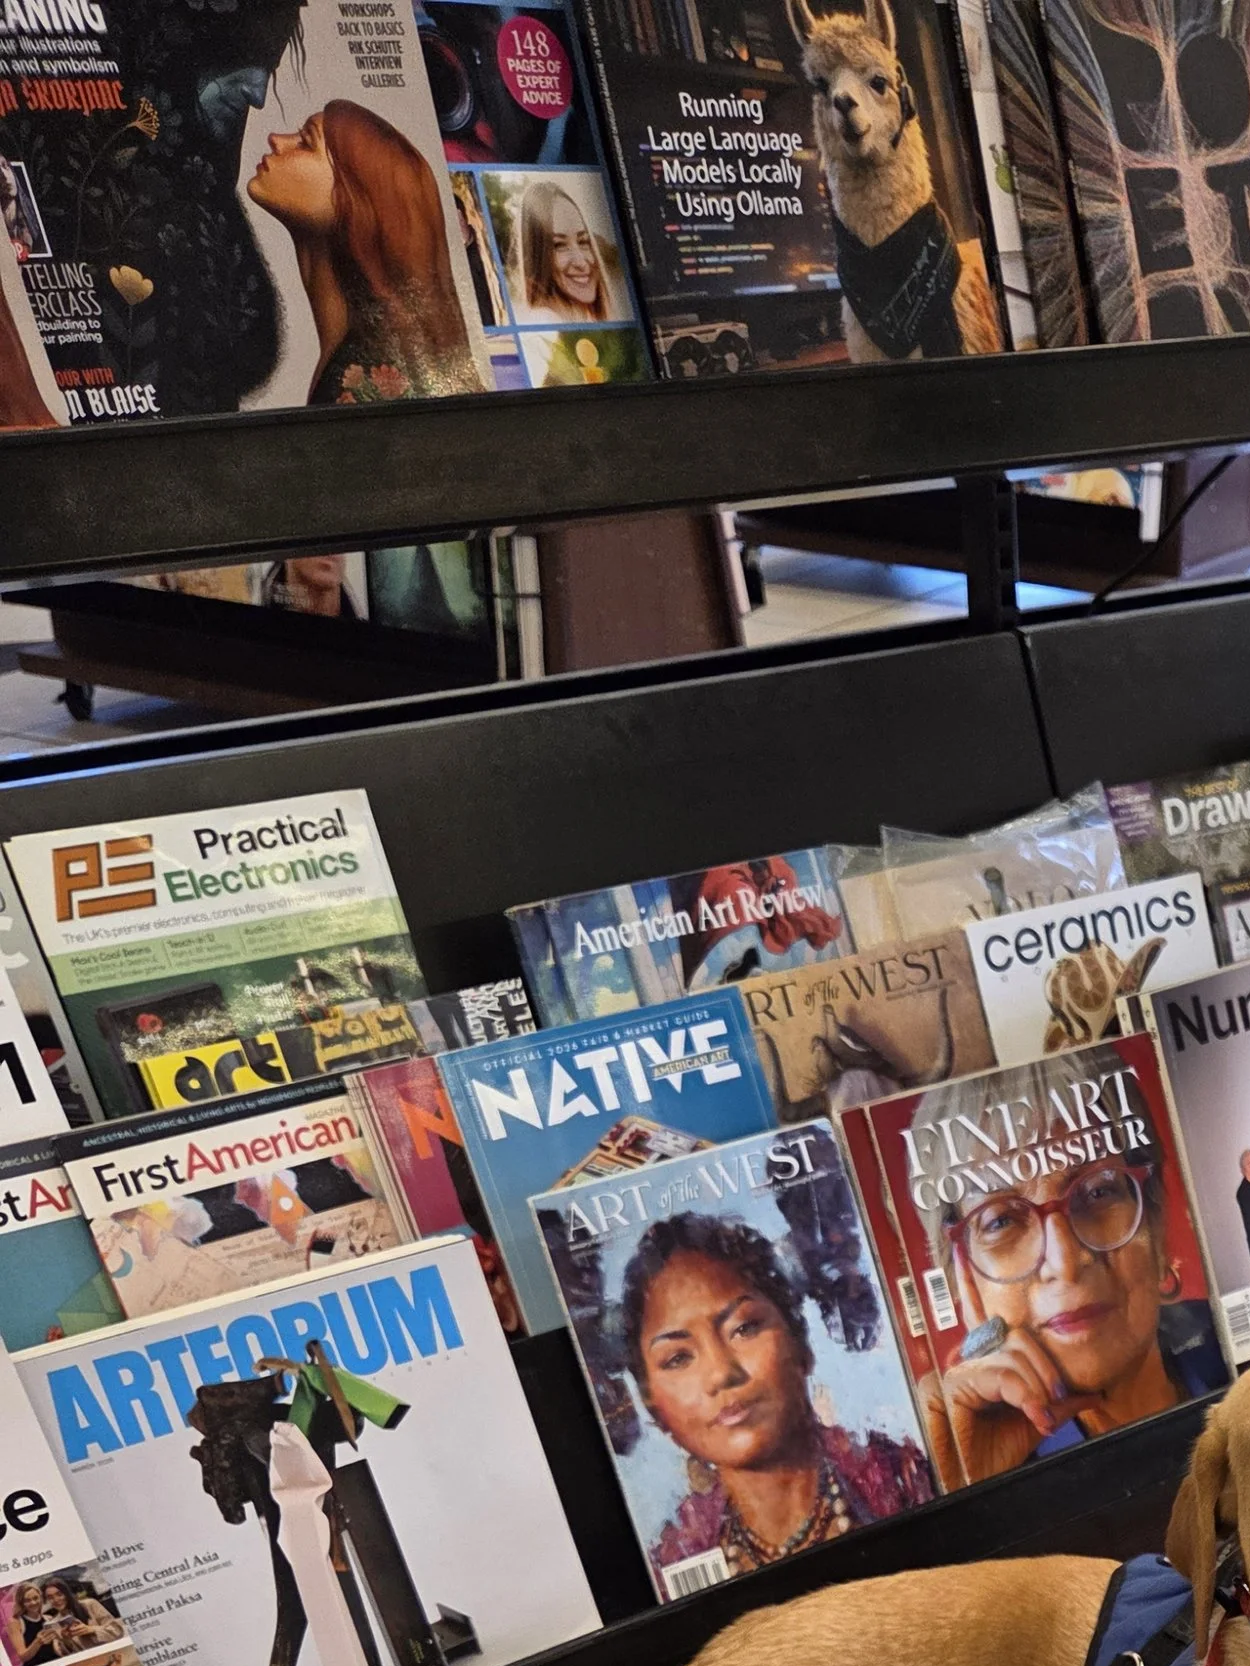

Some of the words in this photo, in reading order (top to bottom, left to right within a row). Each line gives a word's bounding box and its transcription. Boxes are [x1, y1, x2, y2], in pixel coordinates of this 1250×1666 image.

[338, 3, 395, 18] WORKSHOPS
[338, 22, 361, 36] BACK
[361, 22, 374, 35] TO
[374, 21, 405, 36] BASICS
[20, 35, 102, 55] illustrations
[511, 30, 551, 57] 148
[11, 57, 41, 76] and
[43, 57, 120, 79] symbolism
[355, 56, 403, 70] INTERVIEW
[507, 58, 546, 74] PAGES
[546, 60, 563, 73] OF
[361, 73, 406, 89] GALLERIES
[517, 74, 561, 90] EXPERT
[522, 90, 565, 106] ADVICE
[678, 92, 764, 125] Running
[646, 125, 706, 158] Large
[709, 126, 804, 158] Language
[662, 158, 737, 184] Models
[740, 159, 802, 190] Locally
[675, 192, 735, 223] Using
[736, 190, 804, 217] Ollama
[24, 262, 94, 290] TELLING
[58, 331, 104, 346] painting
[88, 319, 101, 331] to
[55, 369, 82, 388] OUR
[83, 367, 115, 385] WITH
[193, 808, 350, 860] Practical
[163, 850, 360, 903] Electronics
[573, 906, 695, 959] American
[698, 895, 739, 933] Art
[738, 876, 824, 925] Review
[61, 933, 87, 946] The
[86, 927, 113, 943] UK's
[984, 890, 1196, 975] ceramics
[744, 982, 798, 1027] RT
[840, 945, 951, 1001] WEST
[483, 1049, 542, 1074] OFFICIAL
[546, 1040, 580, 1058] 2026
[623, 1019, 671, 1040] MARKET
[673, 1009, 712, 1027] GUIDE
[651, 1056, 710, 1080] AMERICAN
[708, 1049, 733, 1067] ART
[471, 1018, 743, 1142] NATIVE
[900, 1096, 1039, 1179] FINE
[1043, 1066, 1142, 1134] ART
[913, 1117, 1153, 1211] CONNOISSEUR
[567, 1180, 652, 1243] ART
[697, 1133, 818, 1199] WEST
[23, 1549, 54, 1567] apps
[111, 1540, 146, 1561] Bove
[143, 1558, 192, 1586] Central
[192, 1550, 221, 1570] Asia
[123, 1604, 166, 1628] rgarita
[165, 1591, 204, 1613] Paksa
[136, 1635, 174, 1656] ursive
